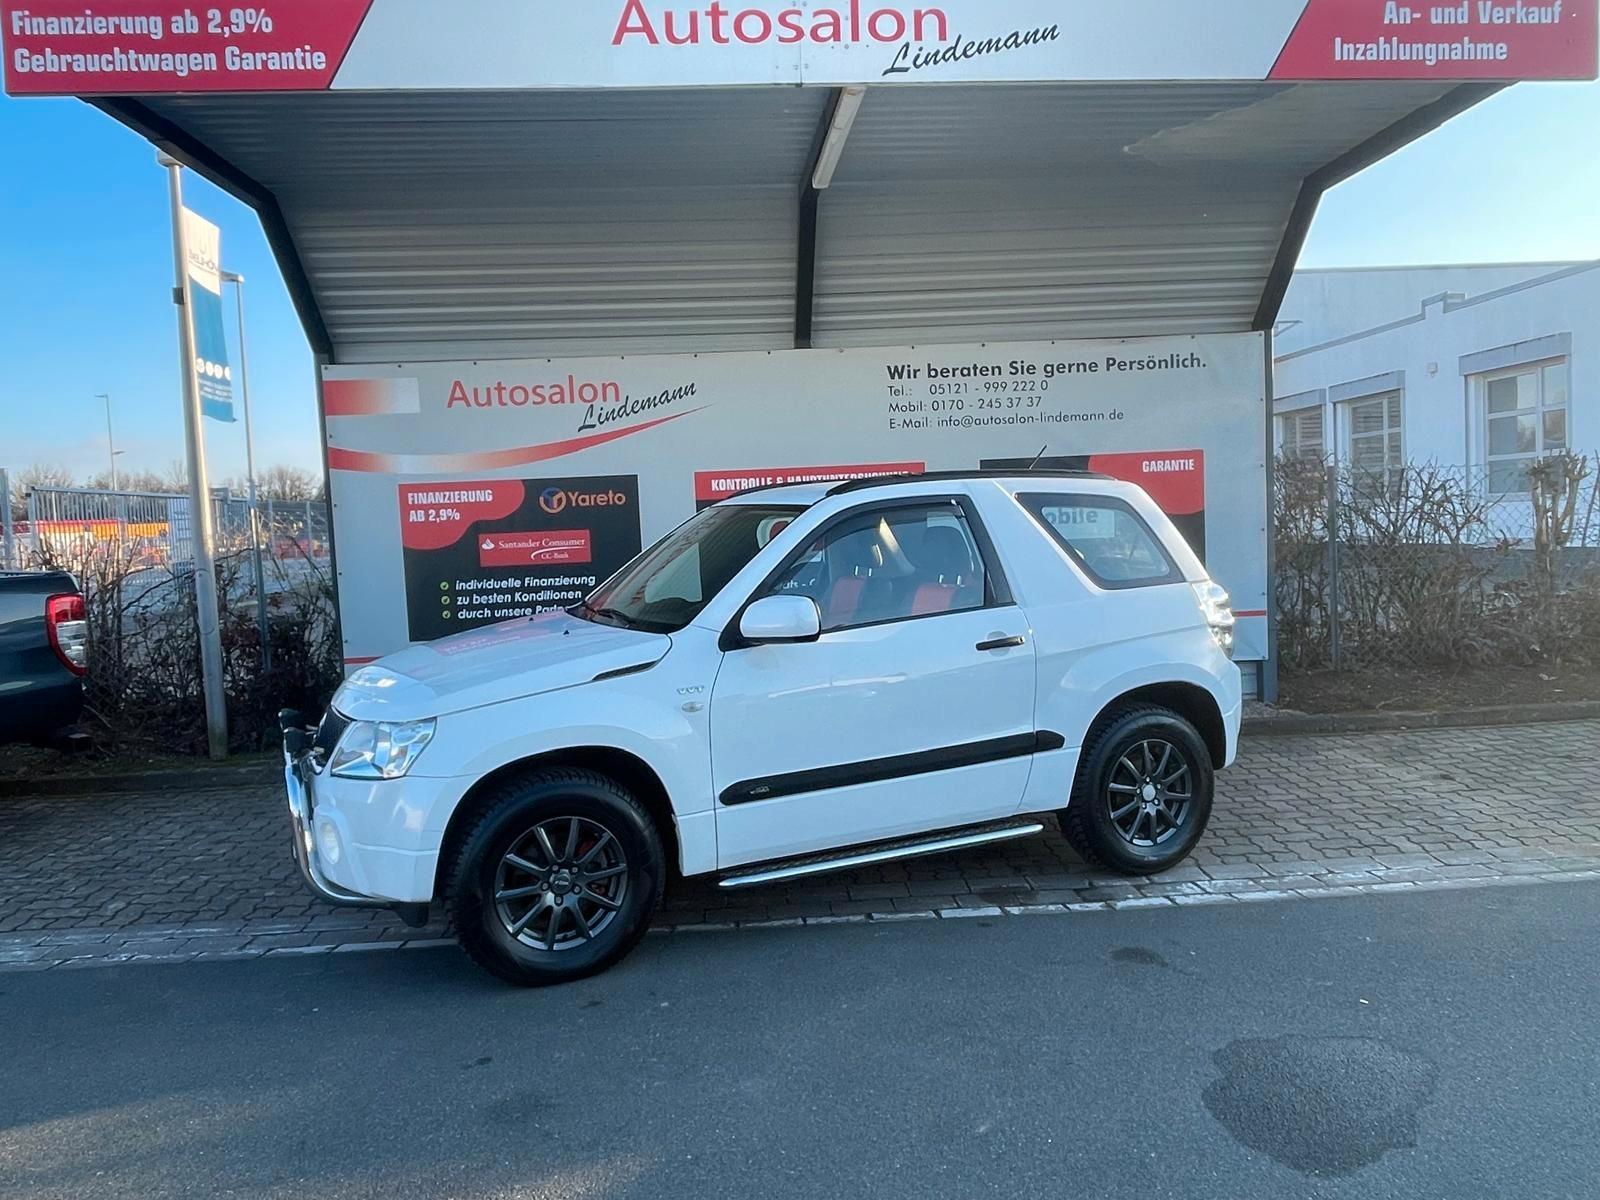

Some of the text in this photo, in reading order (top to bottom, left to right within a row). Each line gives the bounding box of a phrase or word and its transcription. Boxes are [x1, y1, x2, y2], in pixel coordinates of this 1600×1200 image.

[1384, 0, 1562, 25] An- und Verkauf
[11, 8, 273, 39] Finanzierung ab 2,9%
[612, 0, 1060, 77] Autosalon Lindemann
[1334, 37, 1508, 65] Inzahlungnahme
[14, 45, 327, 76] Gebrauchtwagen Garantie
[886, 352, 1207, 380] Wir beraten Sie gerne Persönlich.
[887, 385, 913, 397] Tel.:
[929, 382, 969, 395] 05121
[983, 381, 1008, 393] 999
[1012, 380, 1036, 392] 222
[1040, 379, 1049, 391] 0
[447, 374, 697, 432] Autosalon Lindemann
[888, 401, 928, 413] Mobil:
[931, 399, 965, 411] 0170
[977, 397, 1002, 409] 245
[1006, 396, 1022, 409] 37
[1026, 395, 1042, 408] 37
[889, 408, 1124, 429] E-Mail: info@autosalon-lindemann.de
[1142, 459, 1195, 473] GARANTIE
[711, 476, 773, 492] KONTROLLE
[407, 489, 493, 505] FINANZIERUNG
[568, 489, 626, 508] Yareto
[409, 508, 460, 524] AB 2,9%
[499, 538, 585, 549] Santander Consumer
[541, 551, 569, 560] CC-Bank
[455, 575, 596, 591] individuelle Finanzierung
[456, 590, 582, 606] zu besten Konditionen
[457, 607, 491, 620] durch
[494, 606, 533, 618] unsere
